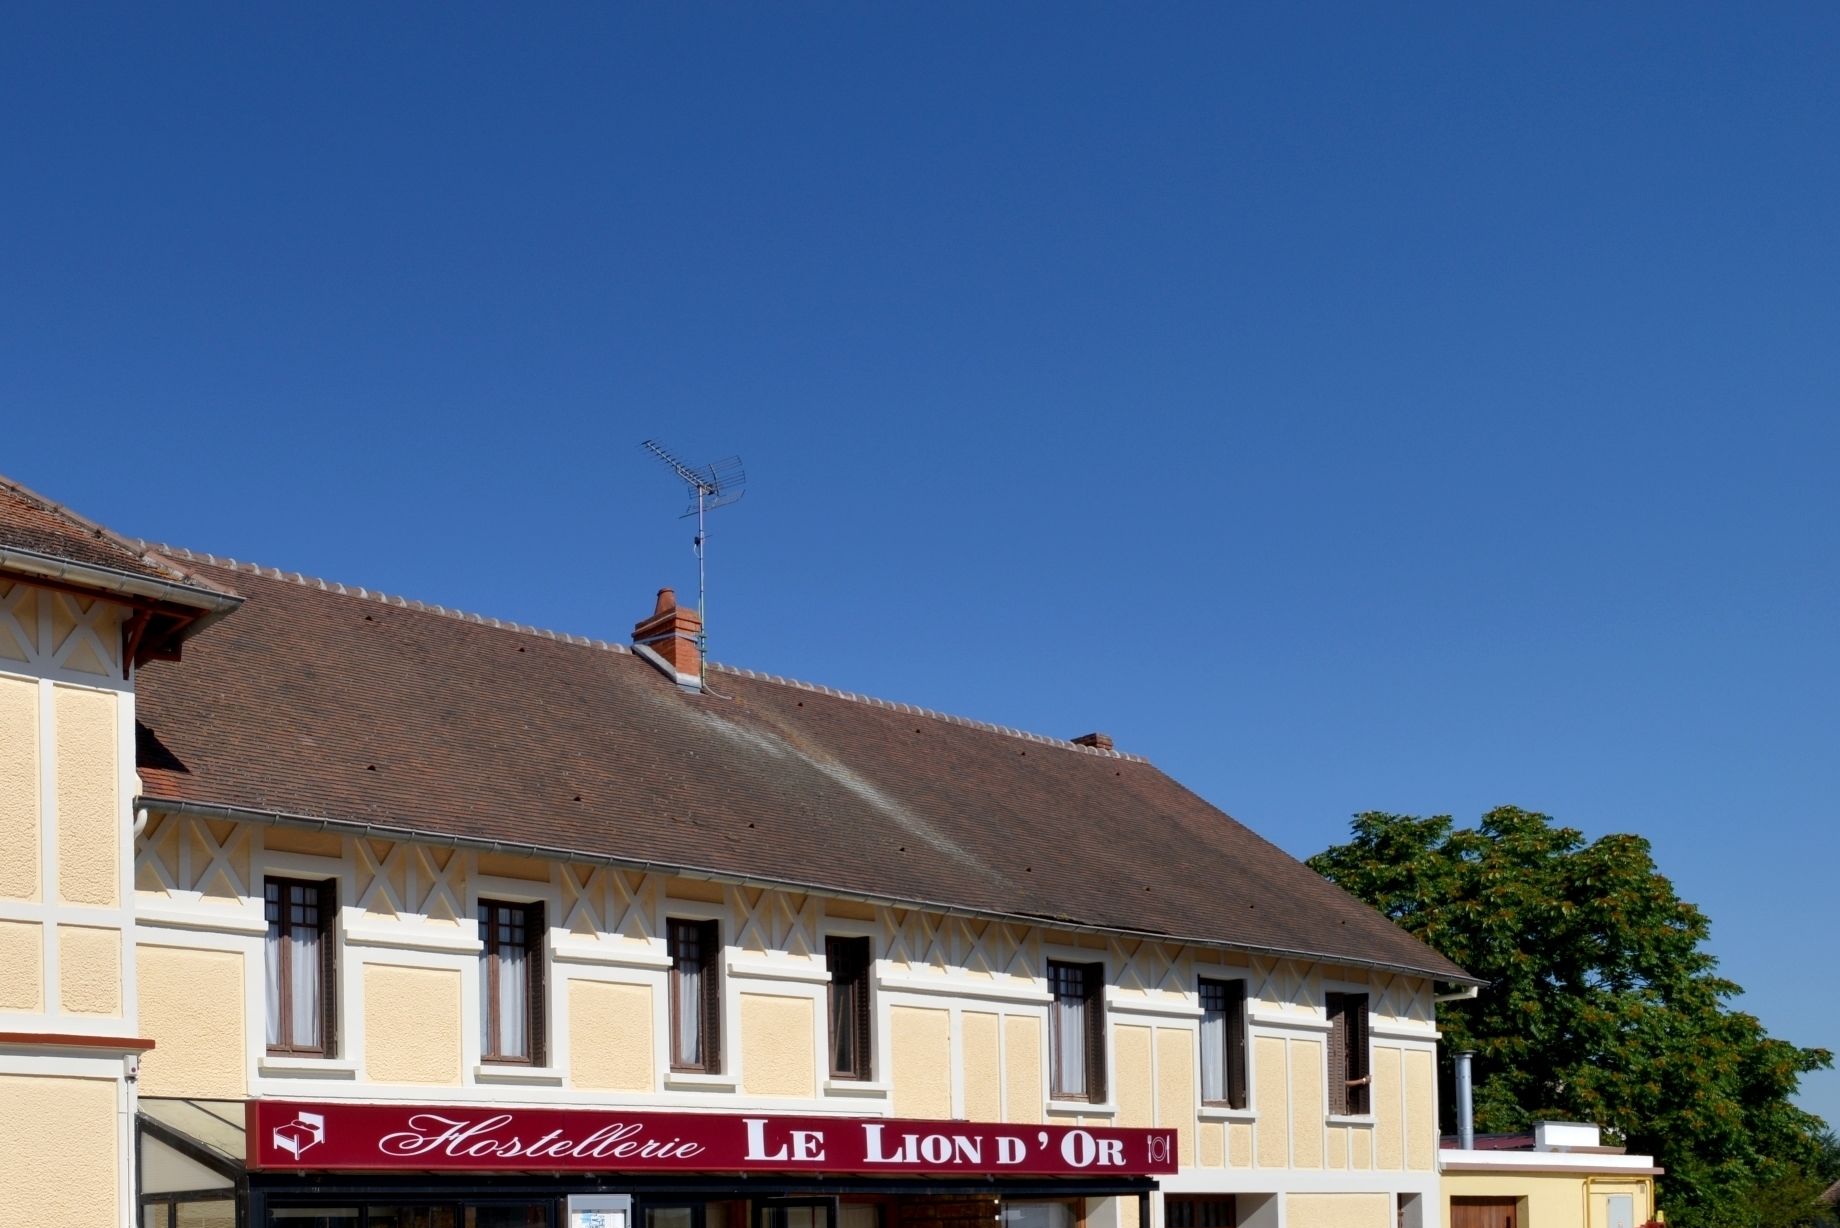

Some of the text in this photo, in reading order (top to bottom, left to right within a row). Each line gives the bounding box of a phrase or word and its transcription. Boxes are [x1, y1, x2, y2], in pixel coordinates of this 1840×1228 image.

[378, 1113, 705, 1160] Hostellerie
[742, 1118, 825, 1162] LE
[861, 1123, 983, 1165] LION
